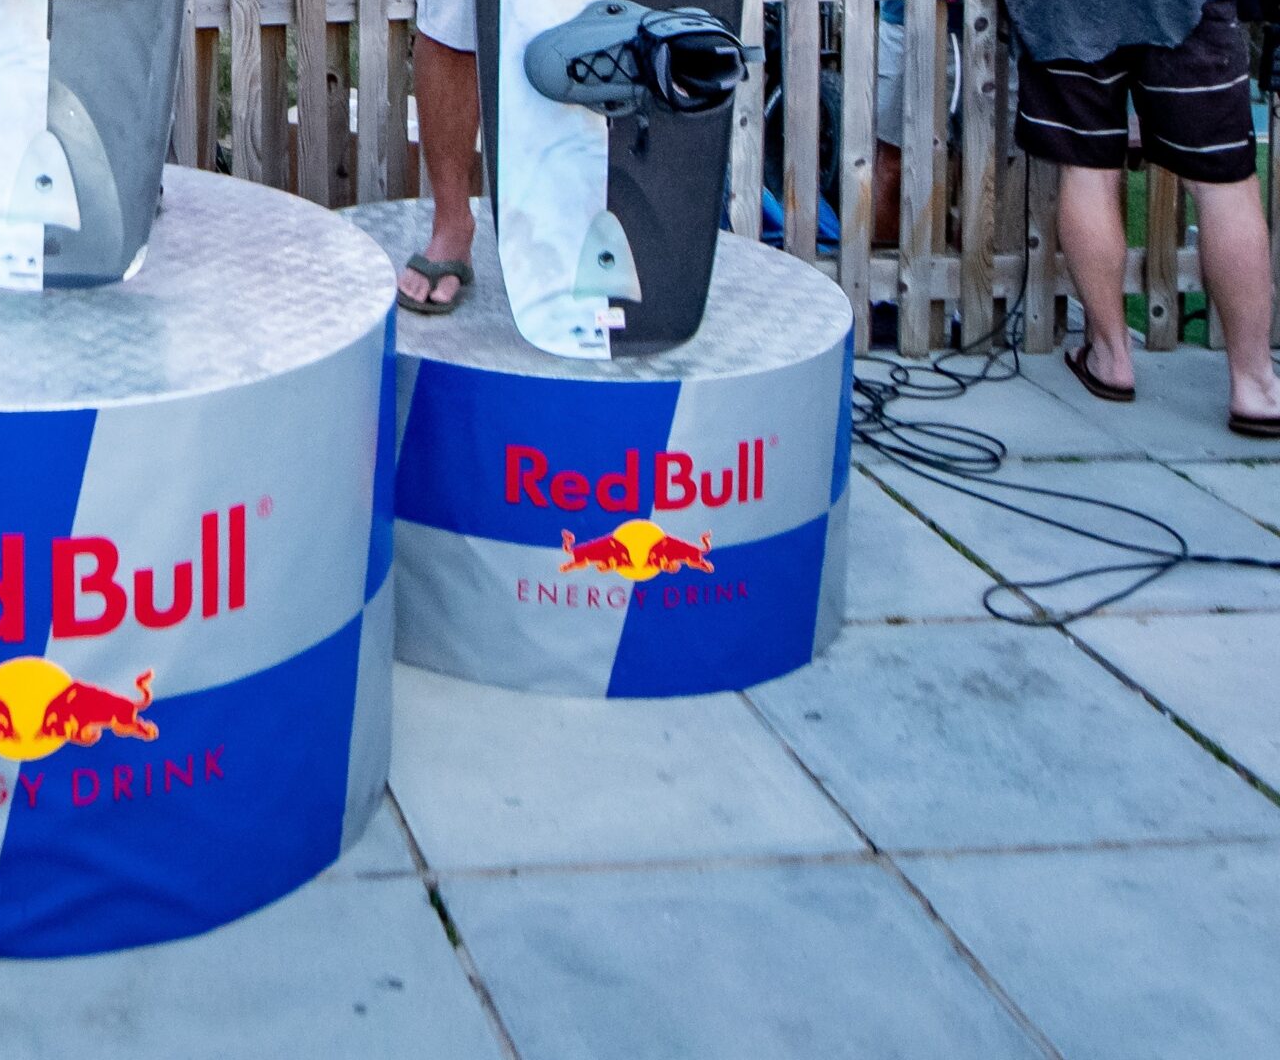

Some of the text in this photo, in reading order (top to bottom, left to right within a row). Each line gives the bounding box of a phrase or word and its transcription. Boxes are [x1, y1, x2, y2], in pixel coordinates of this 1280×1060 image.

[505, 437, 765, 513] Red Bull
[51, 503, 246, 641] Bull
[517, 577, 749, 610] ENERGY DRINK
[72, 742, 227, 808] DRINK
